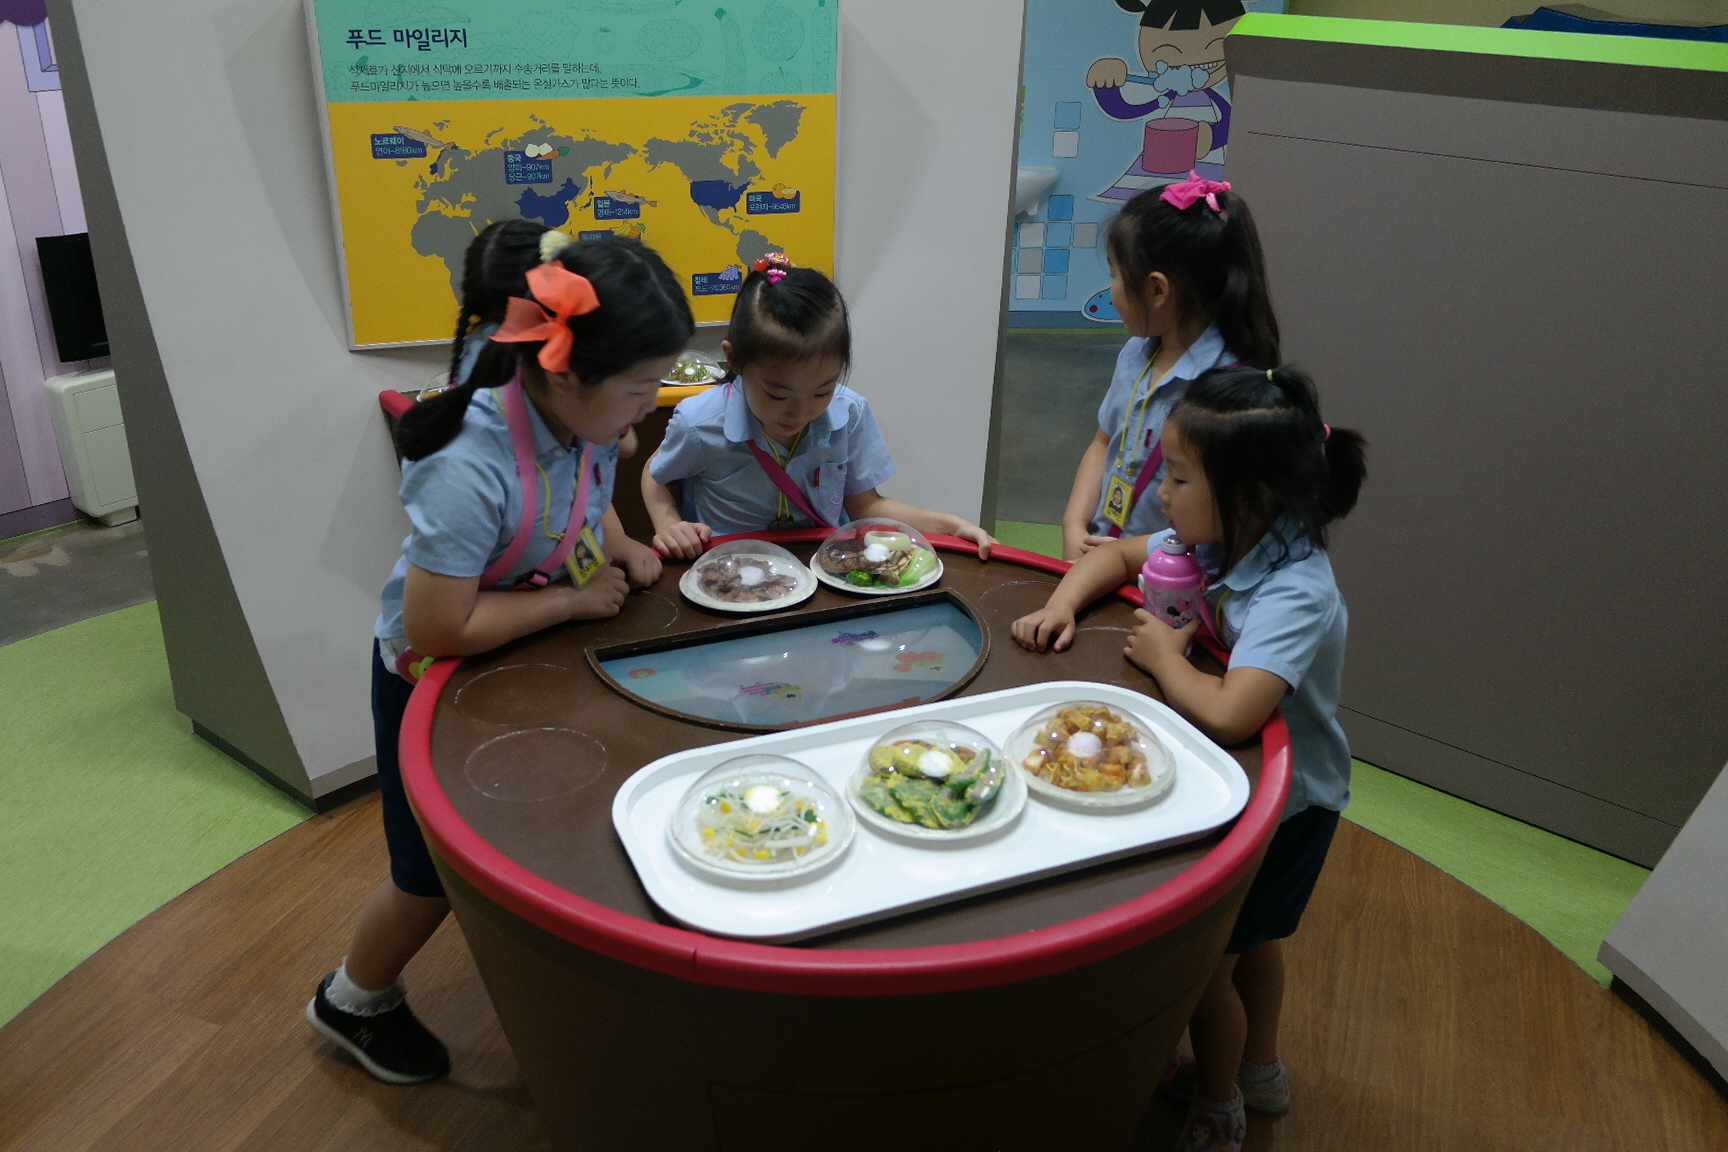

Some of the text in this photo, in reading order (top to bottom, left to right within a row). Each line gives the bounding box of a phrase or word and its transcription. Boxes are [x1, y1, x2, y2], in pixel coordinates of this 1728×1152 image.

[346, 28, 467, 51] 푸드 마일리지
[349, 64, 388, 76] 식재료가
[391, 64, 430, 76] 산지에서
[432, 64, 462, 76] 식탁에
[464, 62, 512, 75] 오르기까지
[515, 62, 560, 75] 수송거리를
[350, 77, 640, 92] 푸드마일리지가 높으면 높을수록 배출되는 온실가스가 많다는 뜻이다.
[374, 136, 405, 146] 노르웨이
[507, 153, 522, 163] 중국
[596, 199, 611, 208] 일본
[748, 194, 762, 203] 미국
[694, 276, 708, 285] 칠레
